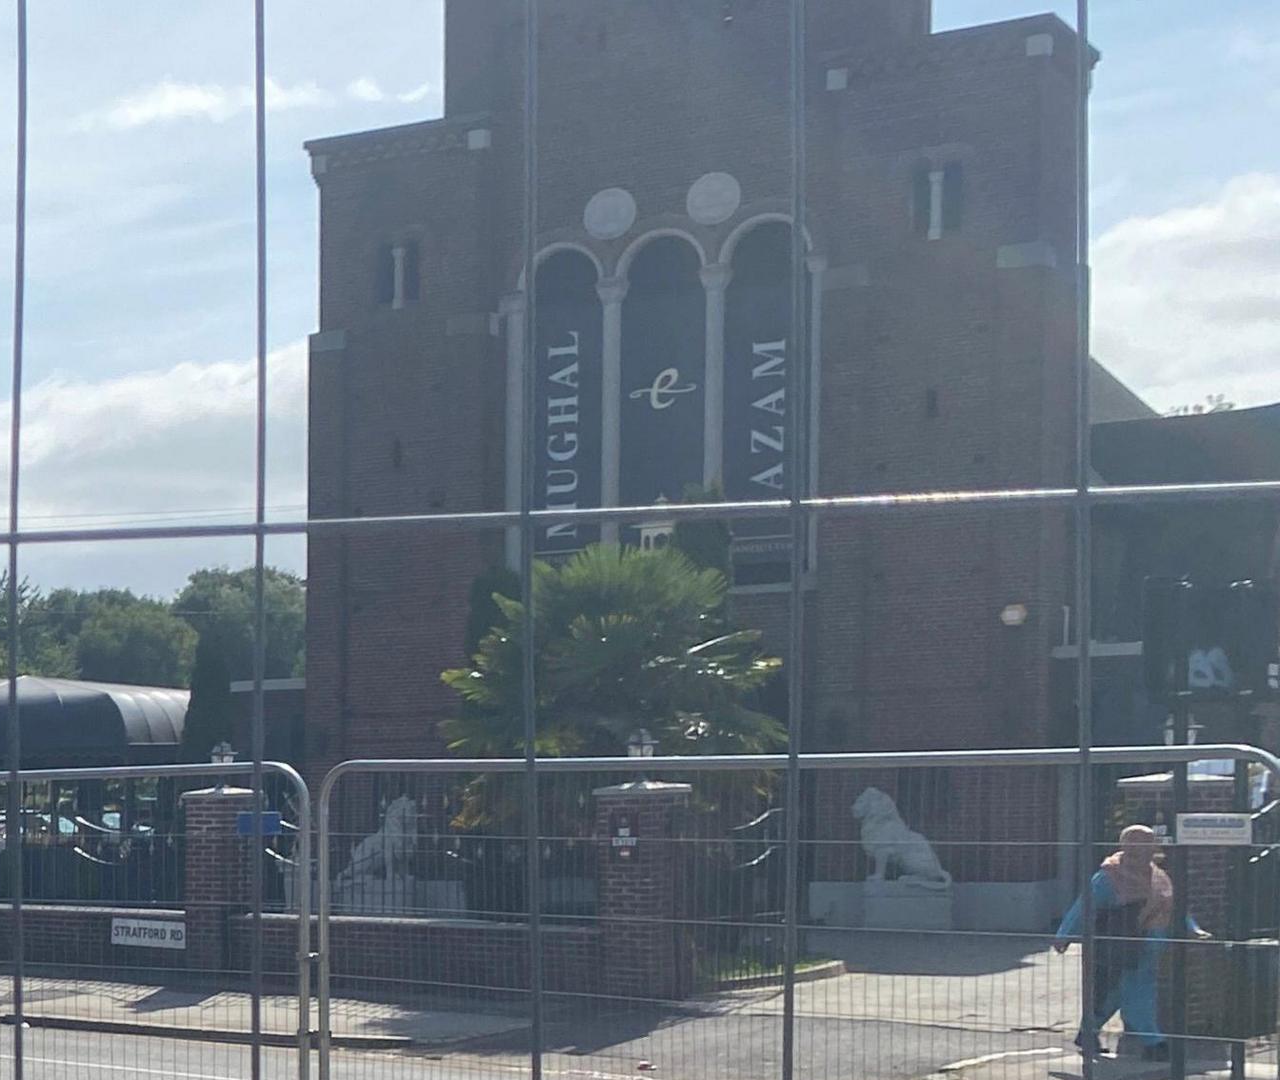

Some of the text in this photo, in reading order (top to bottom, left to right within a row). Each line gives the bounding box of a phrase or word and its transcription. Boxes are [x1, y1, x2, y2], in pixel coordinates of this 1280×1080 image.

[546, 330, 579, 540] MUGHAL
[749, 338, 787, 491] AZAM
[113, 926, 184, 941] STRATFORD RD
